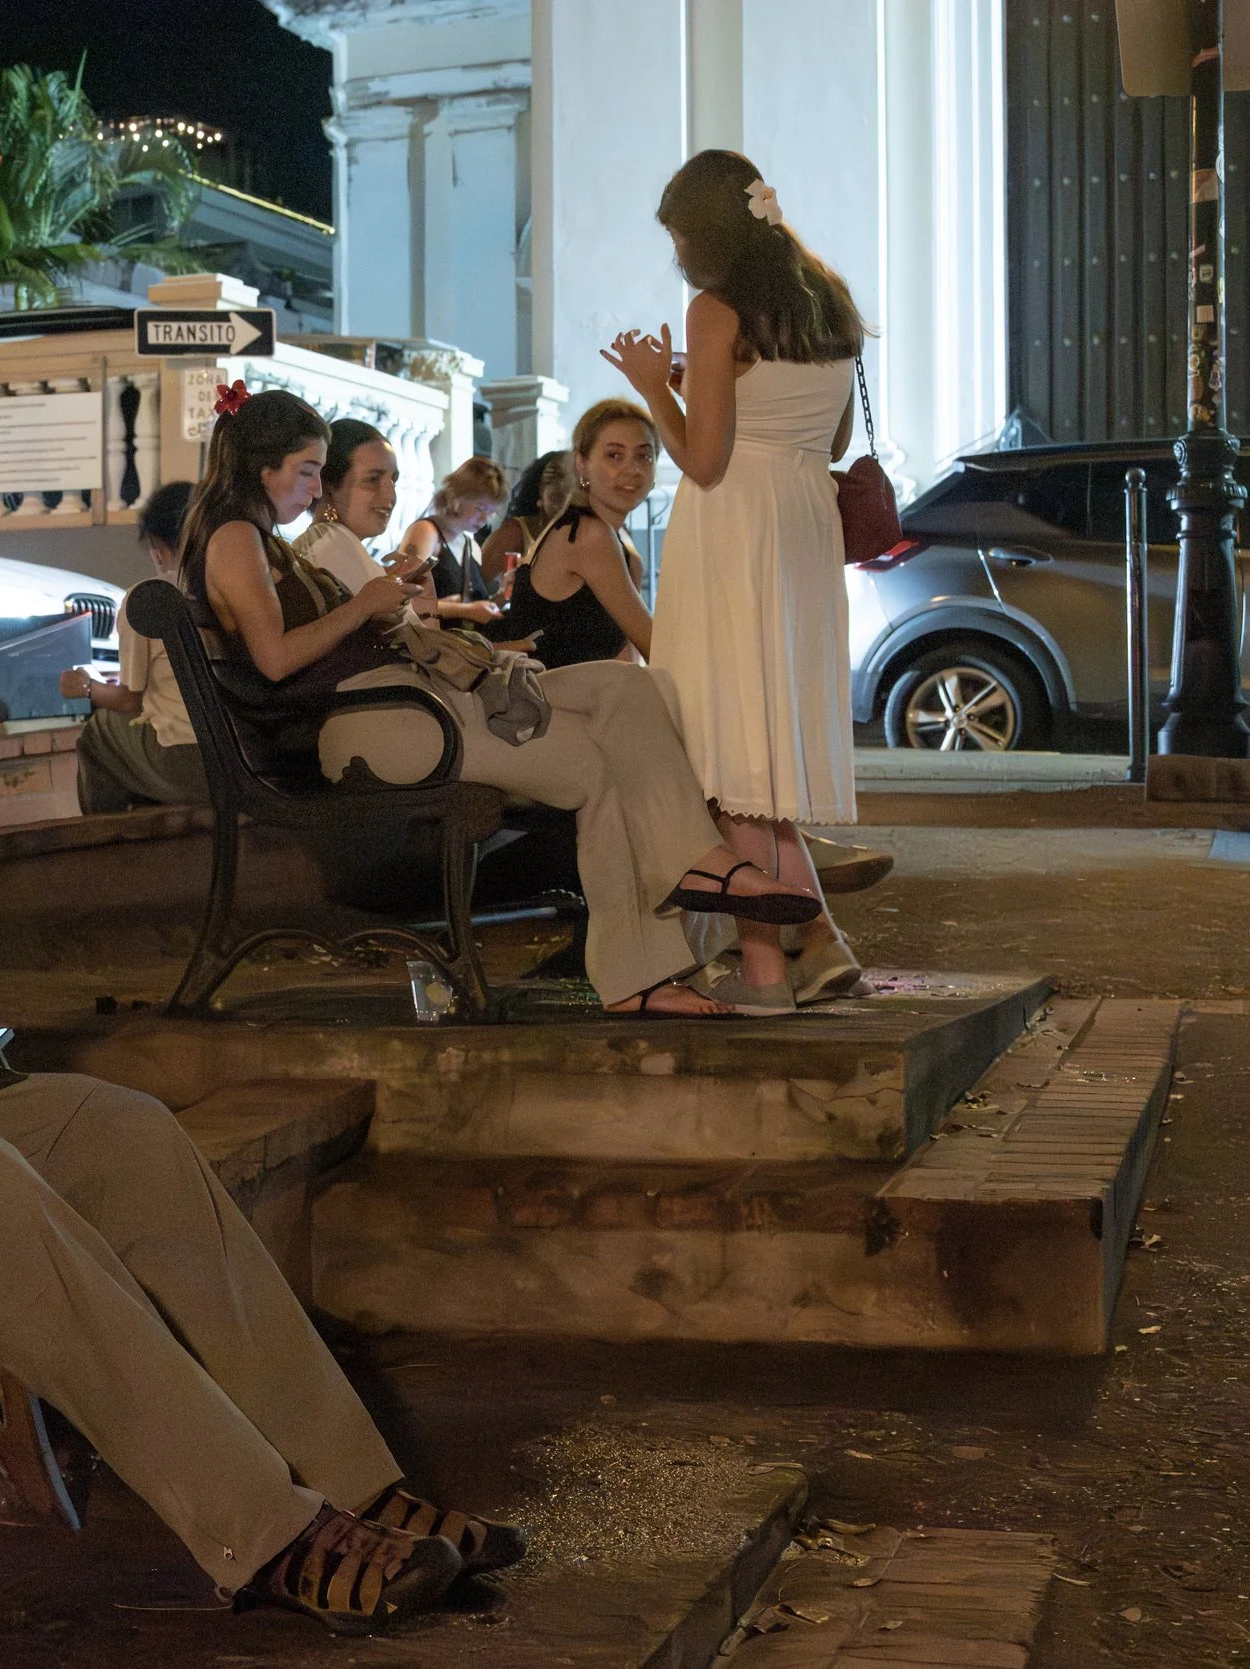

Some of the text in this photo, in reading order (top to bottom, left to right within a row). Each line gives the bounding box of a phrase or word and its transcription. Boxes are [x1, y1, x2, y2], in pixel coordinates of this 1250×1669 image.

[153, 324, 236, 342] TRANSITO
[188, 373, 223, 386] ZONA
[188, 407, 216, 419] TAX
